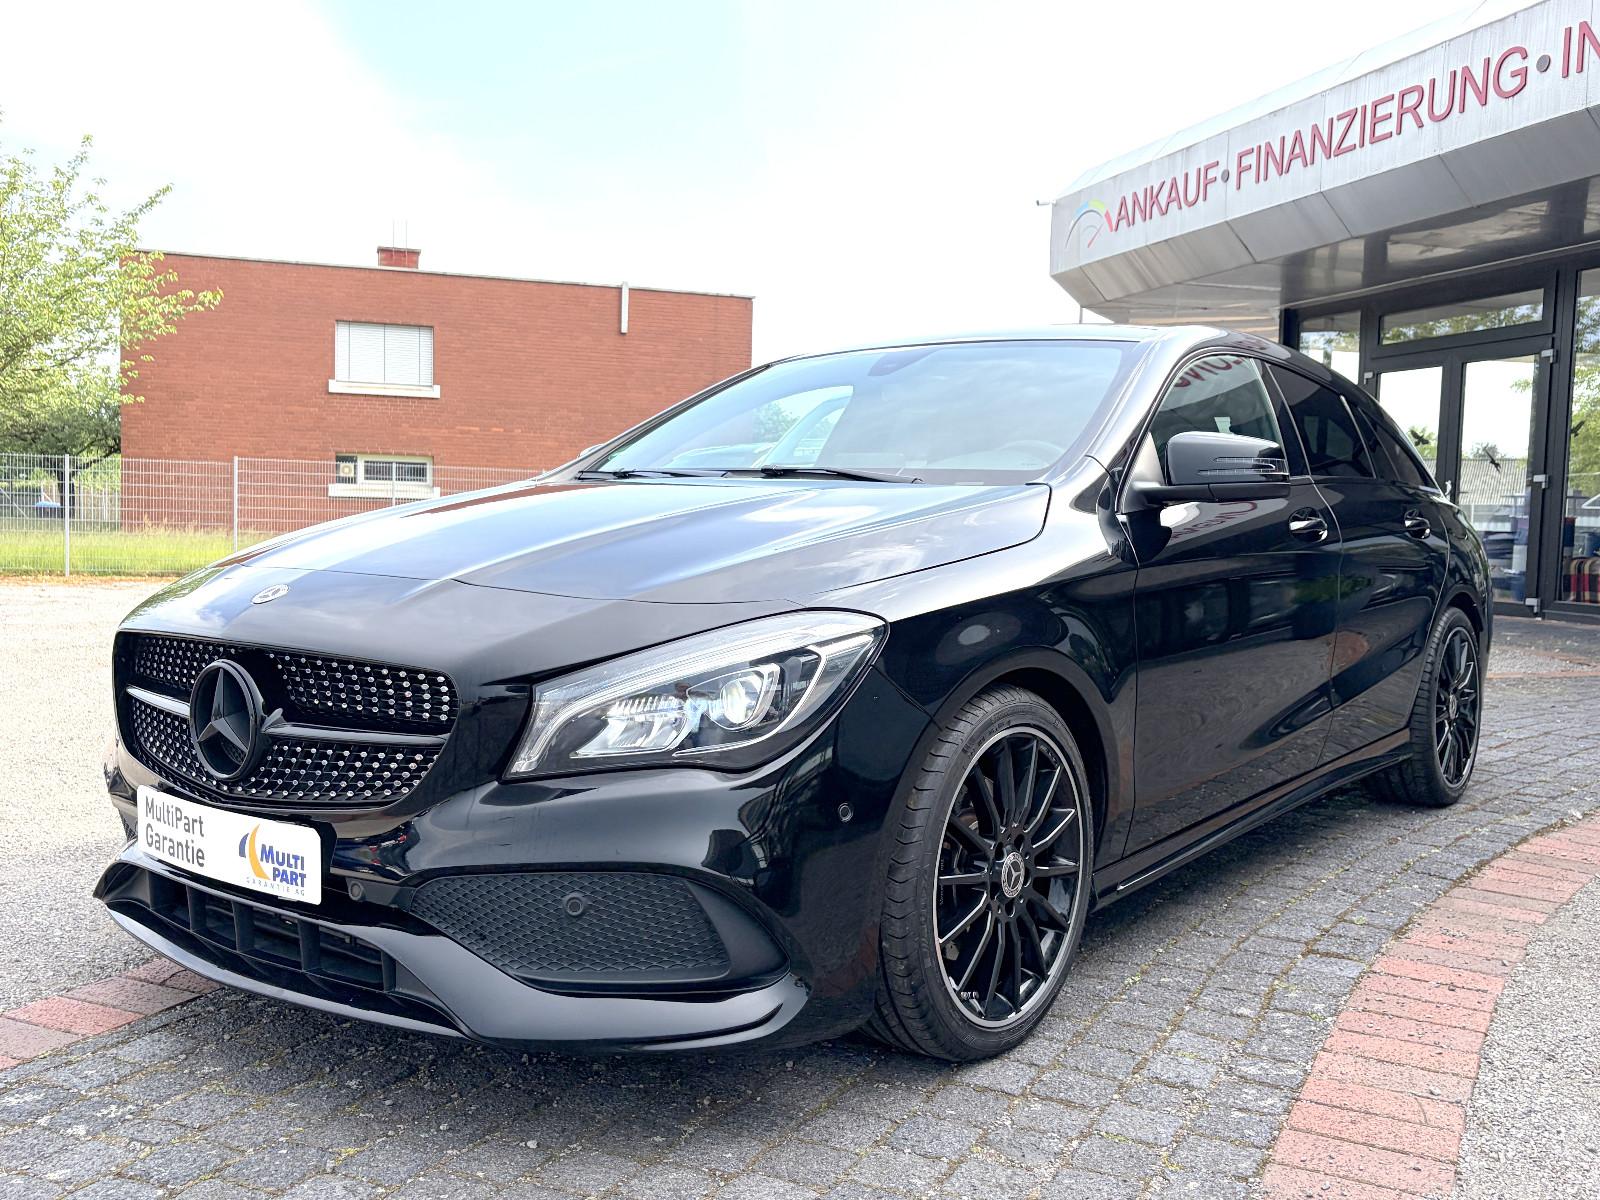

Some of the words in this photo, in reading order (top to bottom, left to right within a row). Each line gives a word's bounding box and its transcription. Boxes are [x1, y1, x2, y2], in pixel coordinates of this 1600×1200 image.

[1114, 160, 1219, 232] ANKAUF
[1235, 46, 1528, 191] FINANZIERUNG
[145, 795, 204, 838] MultiPart
[145, 823, 205, 868] Garantie
[260, 843, 305, 871] MULTI
[246, 876, 290, 893] GARANTIE
[272, 866, 307, 888] PART
